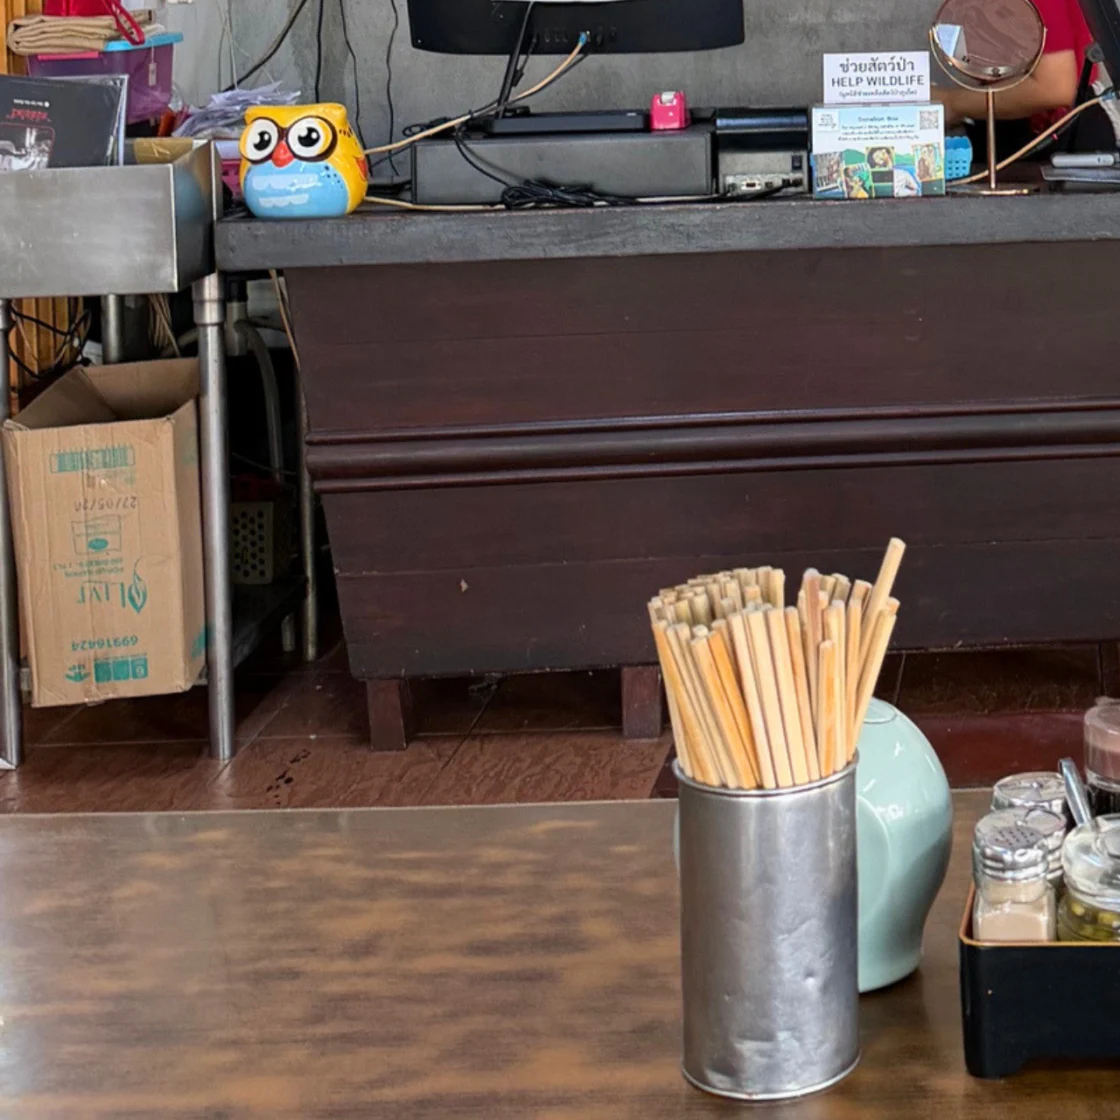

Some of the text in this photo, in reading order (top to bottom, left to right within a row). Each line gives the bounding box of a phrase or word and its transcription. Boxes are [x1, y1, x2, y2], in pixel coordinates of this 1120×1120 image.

[839, 55, 915, 74] ช่วยสัตว์ป่า
[831, 74, 925, 88] HELP WILDLIFE
